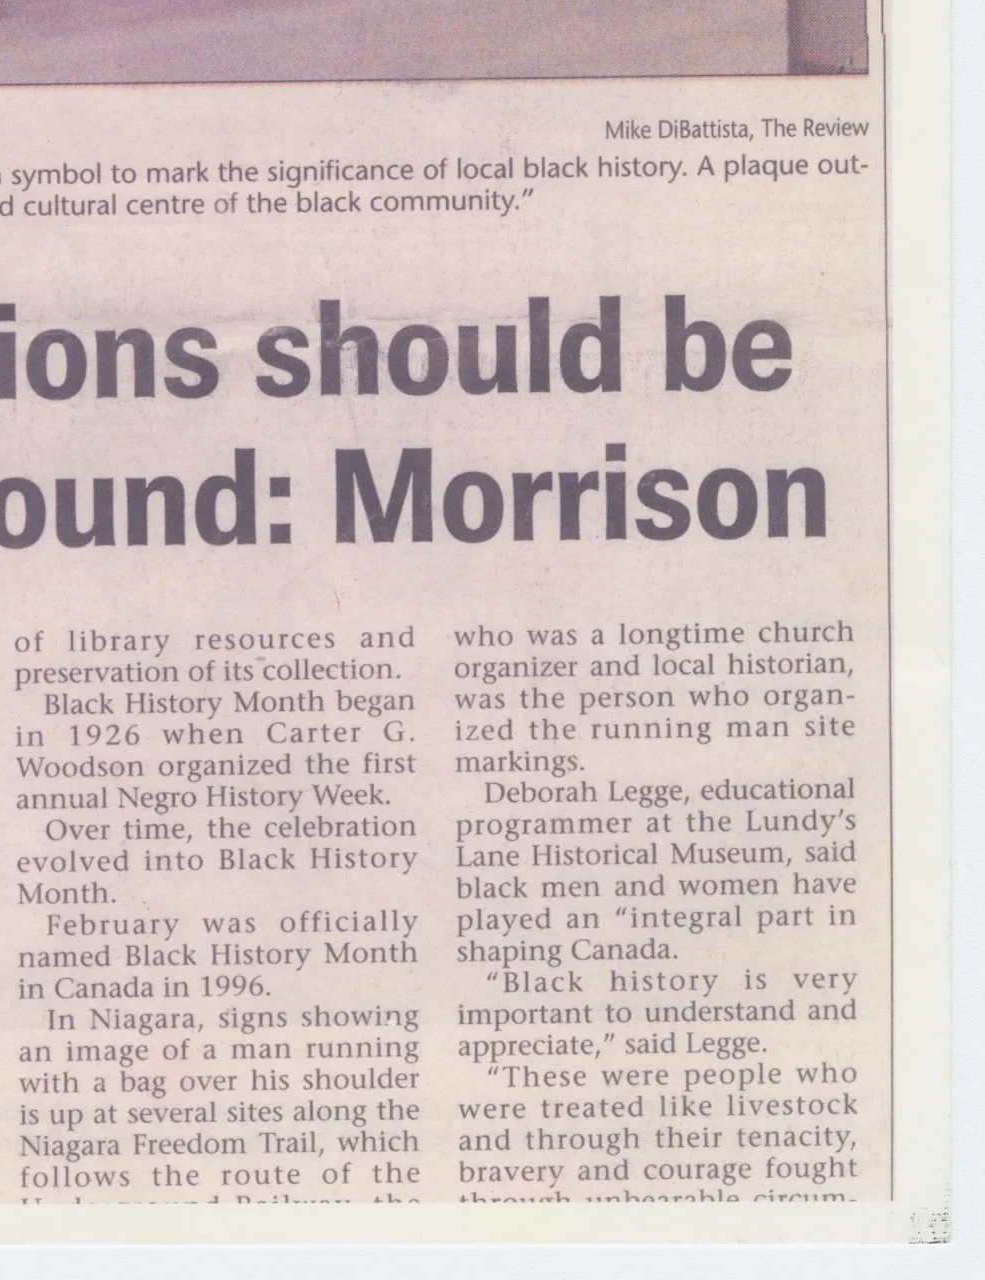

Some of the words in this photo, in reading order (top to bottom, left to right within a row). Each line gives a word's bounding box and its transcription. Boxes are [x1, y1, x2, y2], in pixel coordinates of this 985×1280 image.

[606, 119, 651, 139] Mike
[658, 119, 754, 141] DiBattista,
[761, 118, 796, 137] The
[804, 117, 869, 137] Review
[12, 162, 101, 192] symbol
[111, 164, 137, 184] to
[147, 161, 209, 183] mark
[218, 160, 258, 182] the
[268, 159, 414, 189] significance
[423, 157, 448, 180] of
[457, 157, 513, 180] local
[524, 156, 588, 178] black
[598, 156, 687, 183] history.
[697, 155, 715, 176] A
[724, 154, 808, 183] plaque
[818, 155, 868, 175] out-
[24, 193, 116, 216] cultural
[126, 195, 205, 215] centre
[214, 192, 238, 213] of
[247, 192, 287, 213] the
[297, 190, 361, 213] black
[256, 295, 621, 398] should
[665, 295, 792, 392] be
[335, 443, 826, 543] Morrison
[14, 630, 44, 652] of
[69, 630, 170, 658] library
[195, 632, 335, 650] resources
[360, 626, 415, 648] and
[454, 656, 578, 684] organizer
[590, 654, 640, 677] and
[653, 653, 715, 676] local
[728, 653, 853, 677] historian,
[16, 726, 44, 747] in
[70, 724, 140, 746] 1926
[162, 722, 243, 745] when
[267, 722, 361, 744] Carter
[383, 720, 414, 742] G.
[485, 780, 598, 804] Deborah
[609, 780, 689, 808] Legge,
[701, 777, 855, 801] educational
[45, 819, 110, 841] Over
[124, 818, 192, 843] time,
[207, 816, 251, 839] the
[264, 815, 416, 838] celebration
[457, 846, 519, 867] Lane
[532, 842, 658, 866] Historical
[670, 842, 792, 867] Museum,
[805, 840, 856, 862] said
[18, 979, 44, 999] in
[54, 976, 154, 999] Canada
[164, 977, 190, 997] in
[202, 975, 271, 997] 1996.
[625, 1032, 676, 1054] said
[687, 1032, 767, 1060] Legge.
[20, 1135, 120, 1162] Niagara
[133, 1133, 246, 1155] Freedom
[258, 1131, 324, 1157] Trail,
[338, 1130, 418, 1152] which
[459, 1161, 564, 1188] bravery
[578, 1159, 629, 1181] and
[644, 1163, 751, 1186] courage
[766, 1156, 857, 1184] fought
